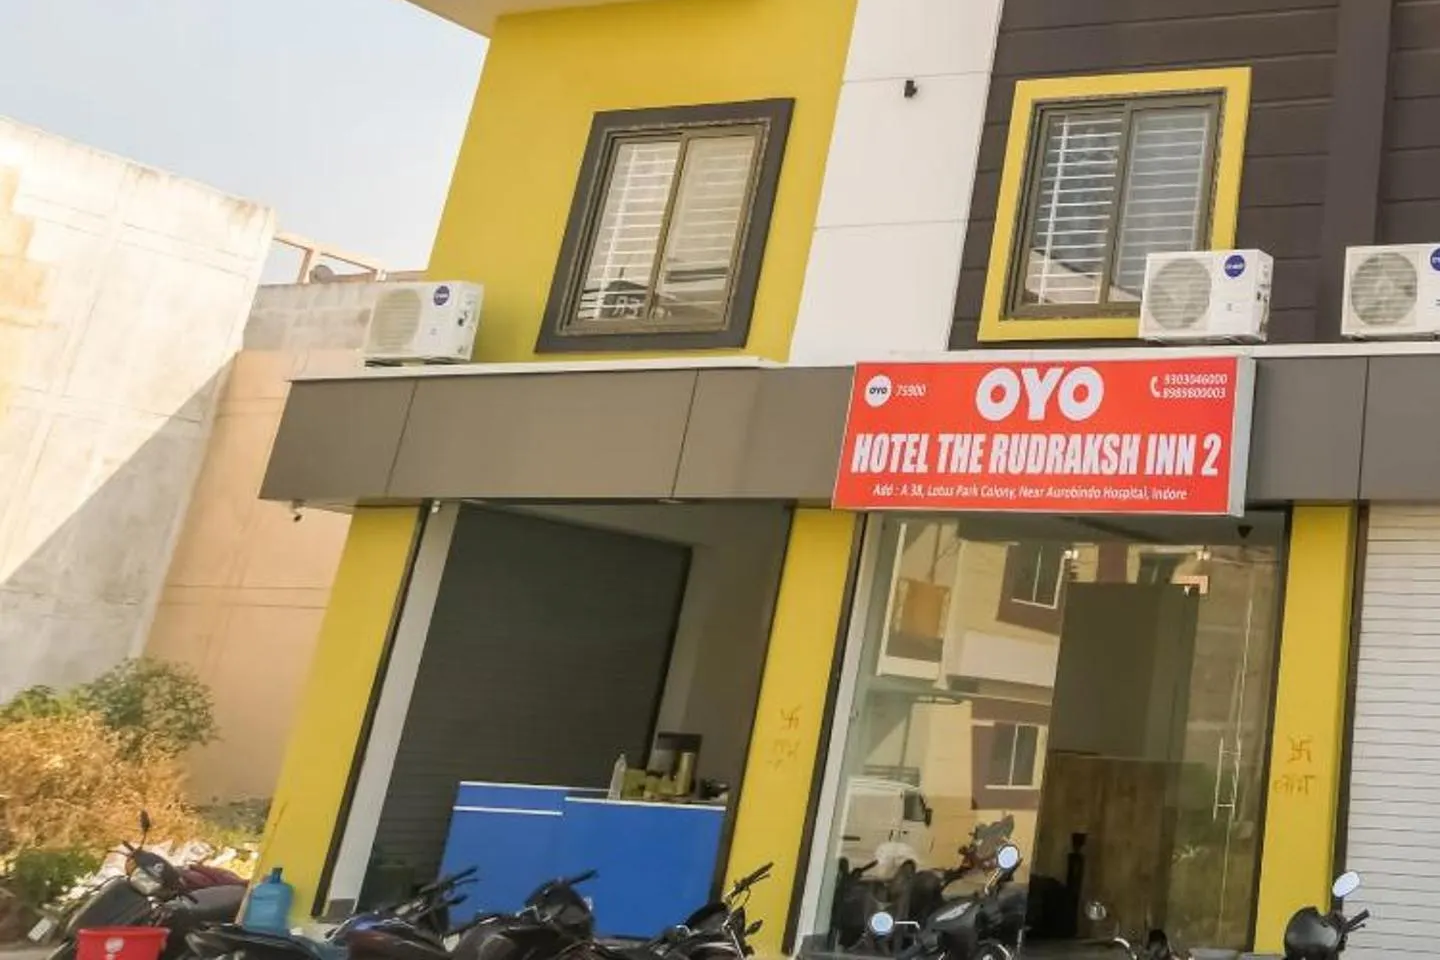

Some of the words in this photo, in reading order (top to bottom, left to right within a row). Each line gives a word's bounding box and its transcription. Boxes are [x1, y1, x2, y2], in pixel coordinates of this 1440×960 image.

[869, 387, 888, 395] OYO
[975, 366, 1104, 421] OYO
[851, 433, 929, 474] HOTEL
[937, 433, 986, 474] THE
[988, 433, 1141, 476] RUDRAKSH
[1145, 434, 1196, 476] INN
[1201, 433, 1222, 477] 2
[928, 485, 954, 497] Lotus
[956, 484, 978, 497] Park
[1019, 486, 1044, 498] Near
[1046, 485, 1100, 499] Aurobindo
[1152, 488, 1187, 500] Indore
